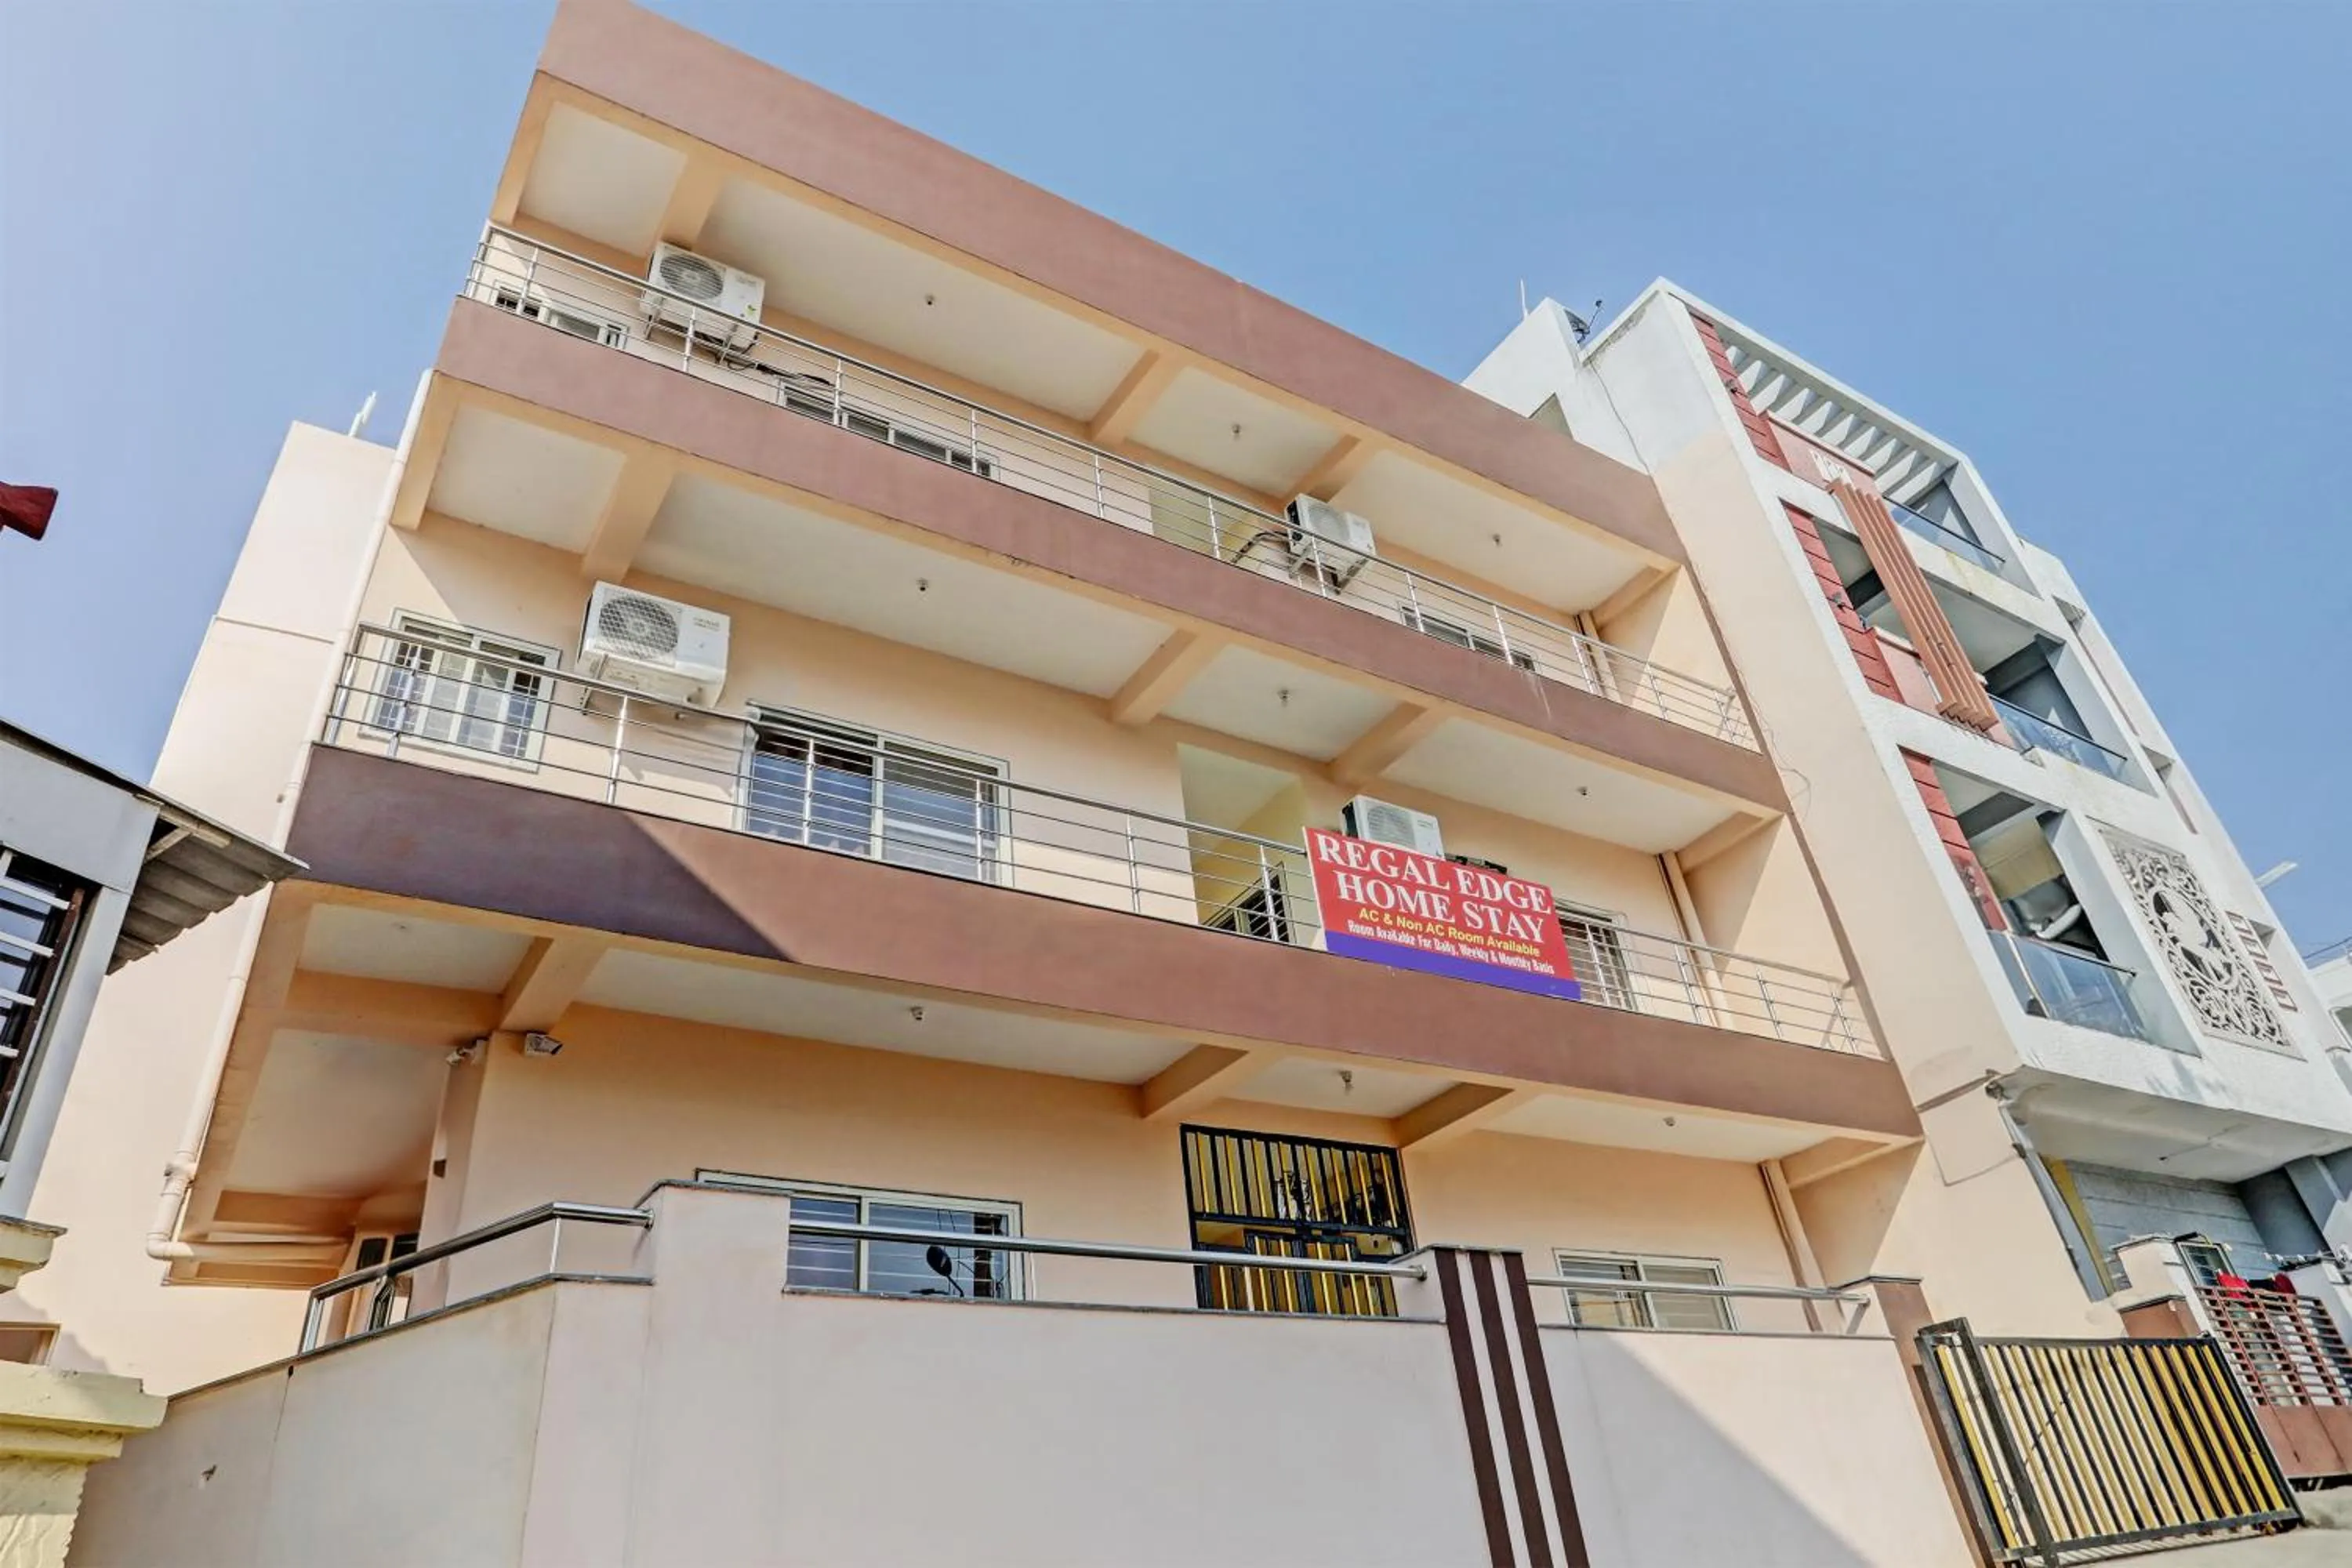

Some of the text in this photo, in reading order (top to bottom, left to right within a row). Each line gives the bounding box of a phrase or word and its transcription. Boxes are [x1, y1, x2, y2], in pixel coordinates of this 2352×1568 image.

[1314, 833, 1552, 914] REGAL EDGE
[1334, 870, 1544, 943] HOME STAY
[1359, 907, 1541, 956] AC & Non AC Room Available
